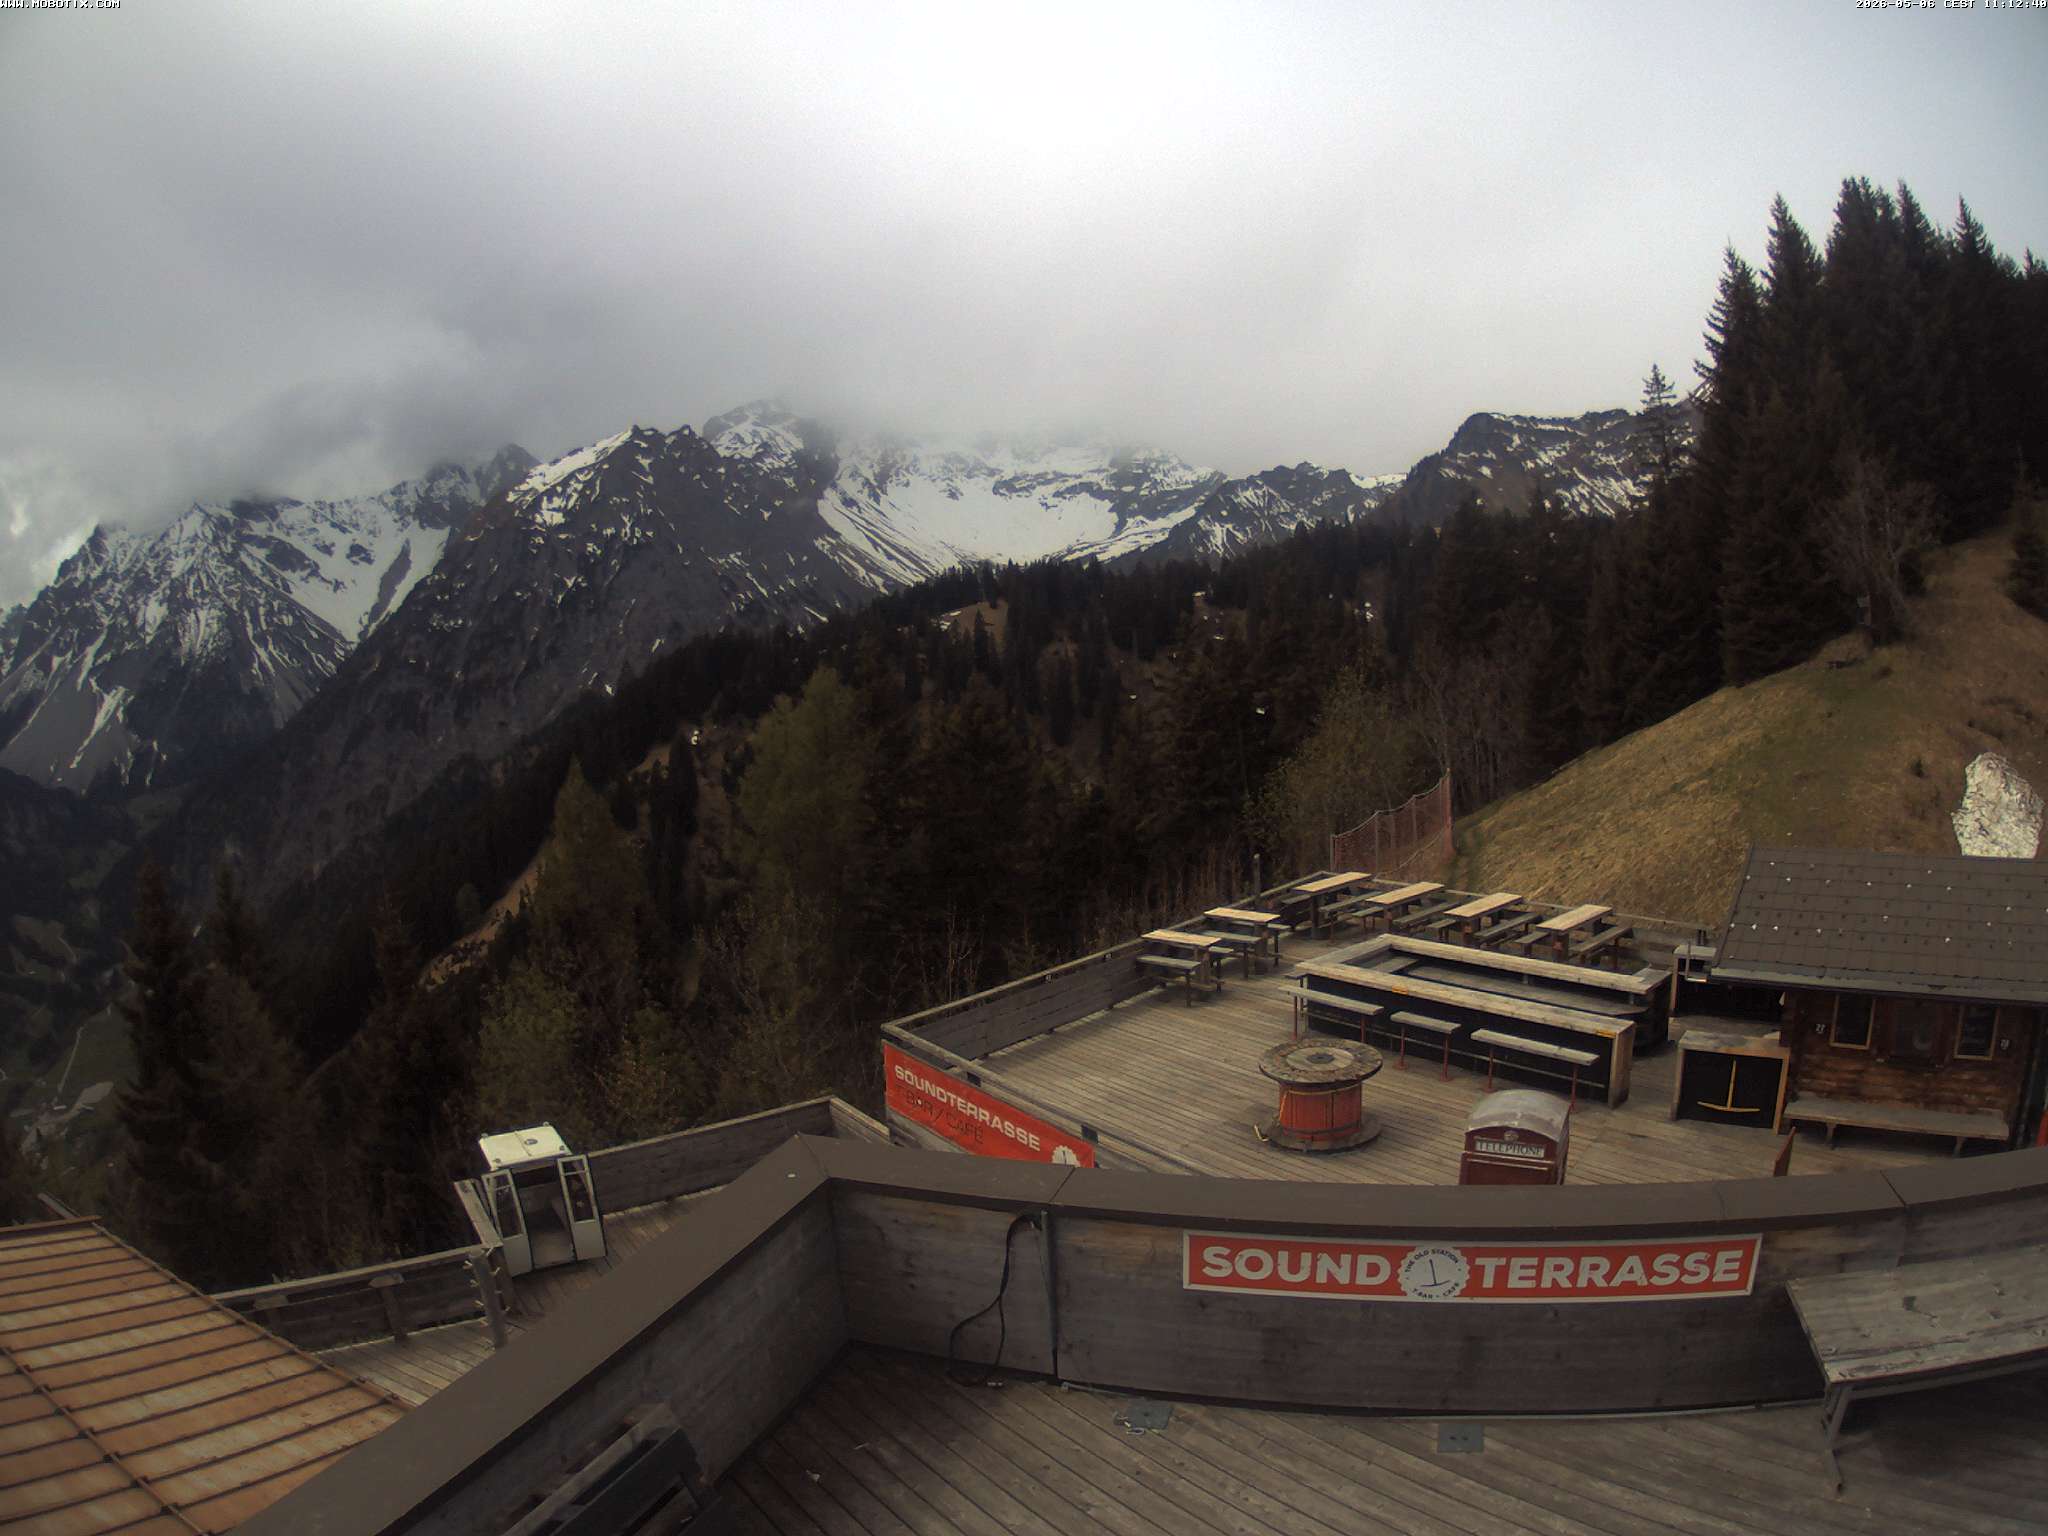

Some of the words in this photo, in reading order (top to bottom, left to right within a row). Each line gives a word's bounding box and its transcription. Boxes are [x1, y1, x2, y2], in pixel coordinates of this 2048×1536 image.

[894, 1064, 1041, 1151] SOUNDTERRASSE
[1479, 1141, 1542, 1156] TELEPHONE
[1202, 1246, 1392, 1285] SOUND
[1474, 1250, 1743, 1289] TERRASSE
[1404, 1259, 1416, 1273] THE
[1414, 1249, 1429, 1260] OLD
[1431, 1248, 1459, 1264] STATION
